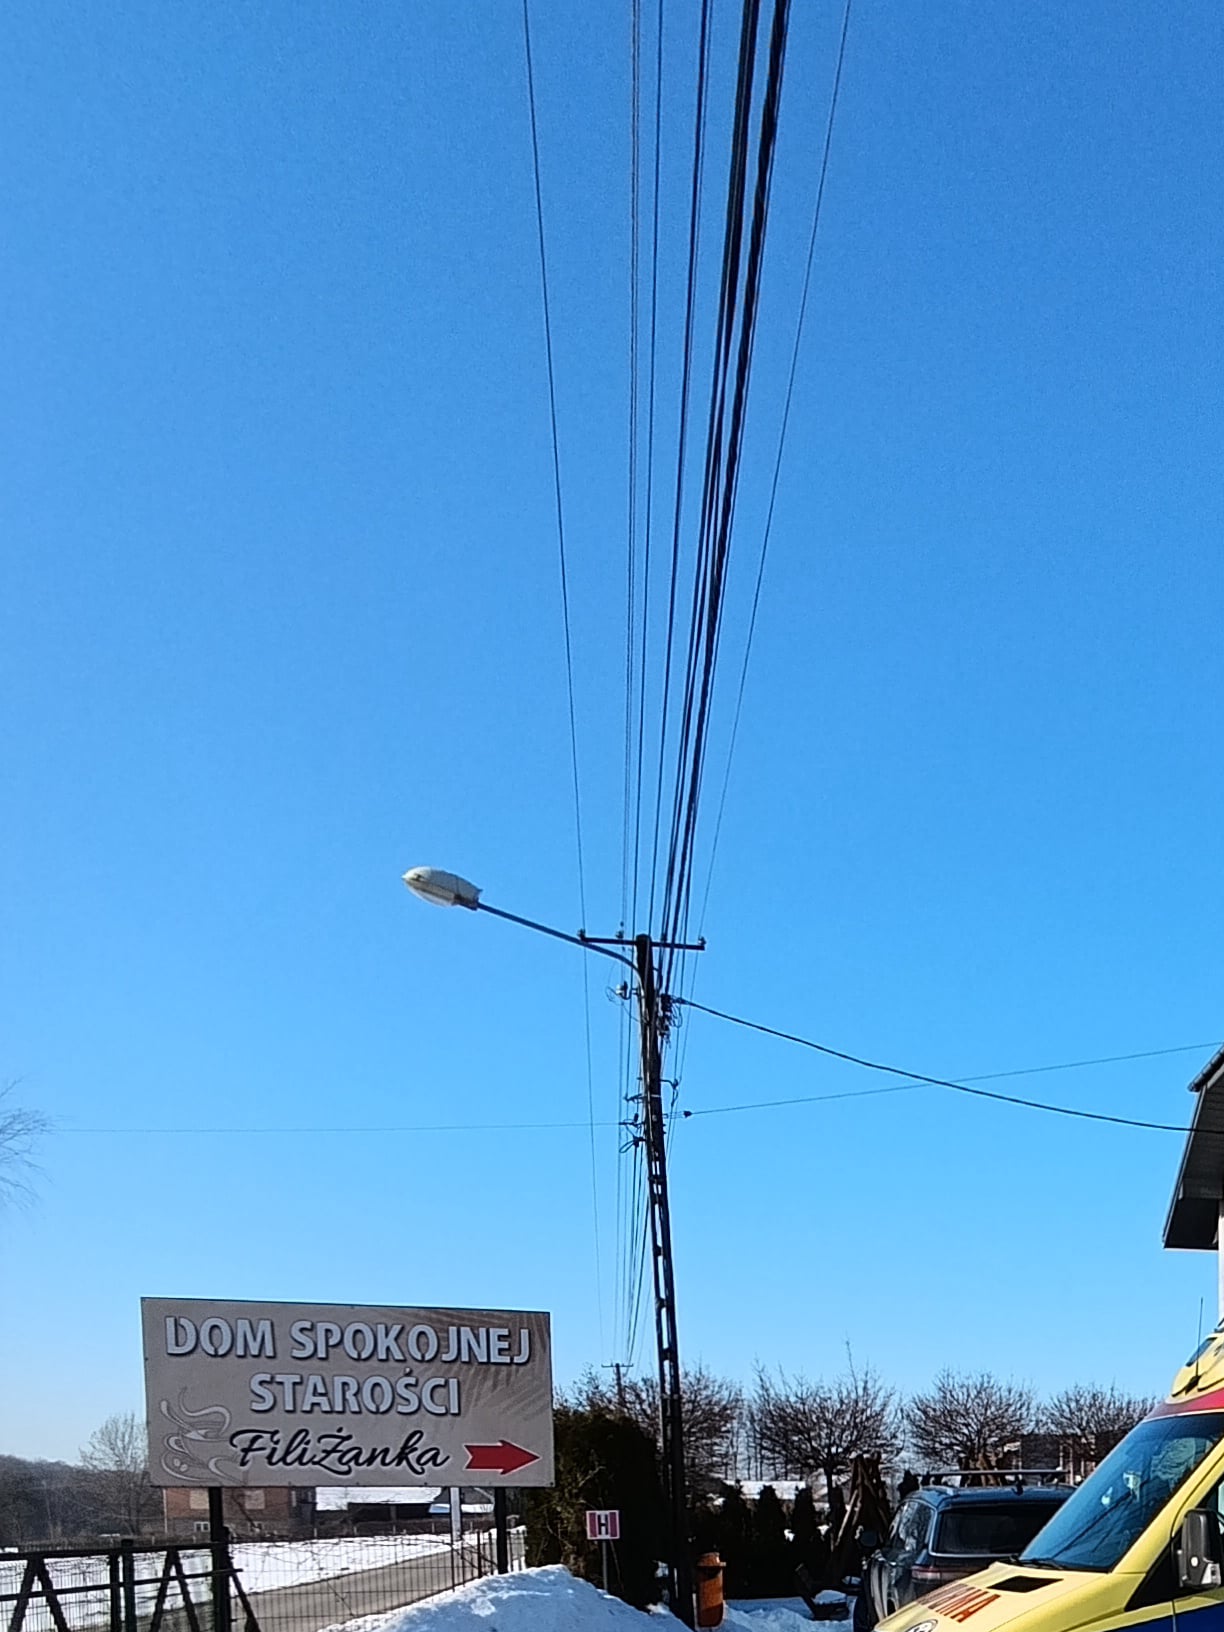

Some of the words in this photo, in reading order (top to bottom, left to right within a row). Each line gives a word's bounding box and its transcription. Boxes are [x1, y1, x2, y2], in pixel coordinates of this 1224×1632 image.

[165, 1316, 276, 1358] DOM
[290, 1320, 531, 1365] SPOKOJNEJ
[249, 1367, 462, 1416] STAROŚCI
[597, 1514, 609, 1536] H
